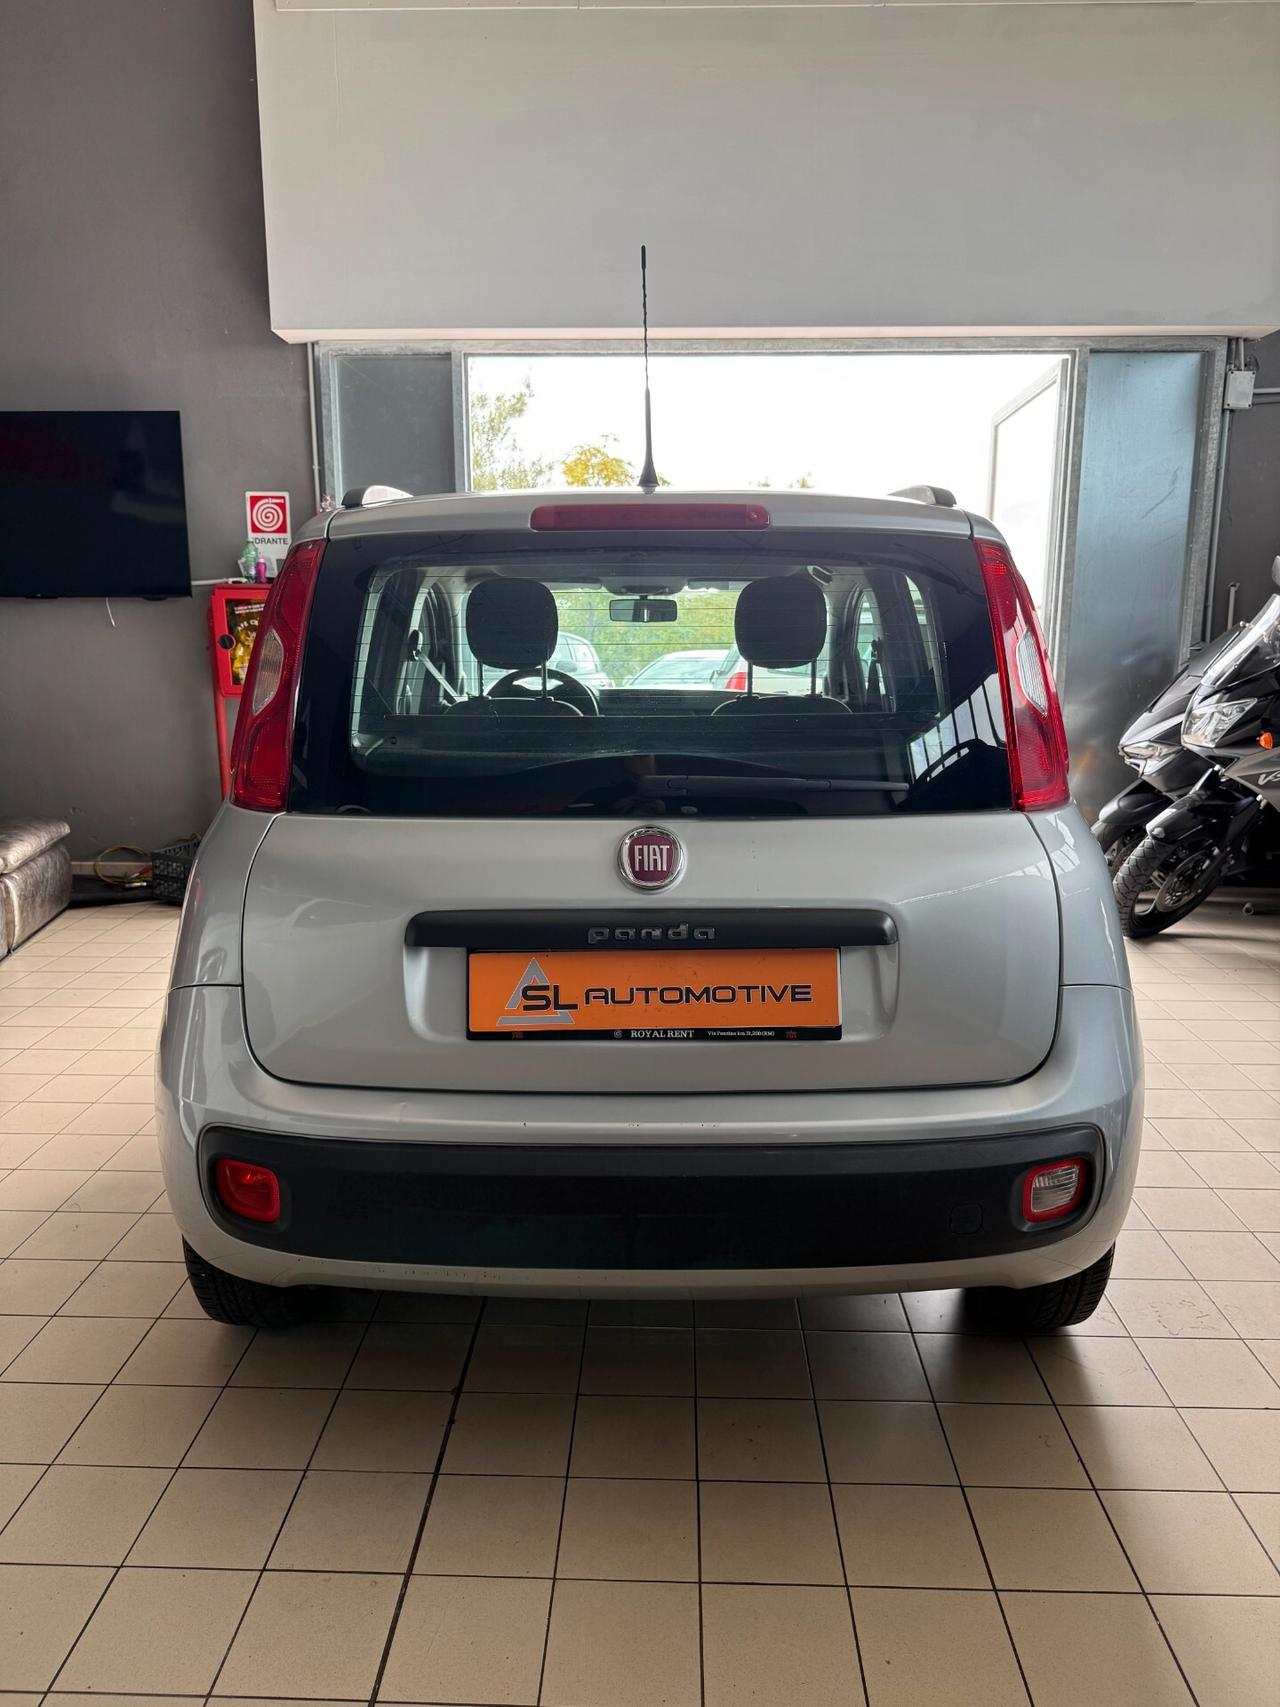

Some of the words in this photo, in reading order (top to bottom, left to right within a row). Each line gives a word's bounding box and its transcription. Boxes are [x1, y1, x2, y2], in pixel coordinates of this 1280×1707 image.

[253, 537, 289, 545] DRANTE
[634, 845, 670, 871] FIAT
[588, 924, 715, 944] panda
[584, 984, 812, 1005] AUTOMOTIVE
[630, 1030, 666, 1038] ROYAL
[667, 1030, 695, 1038] RENT
